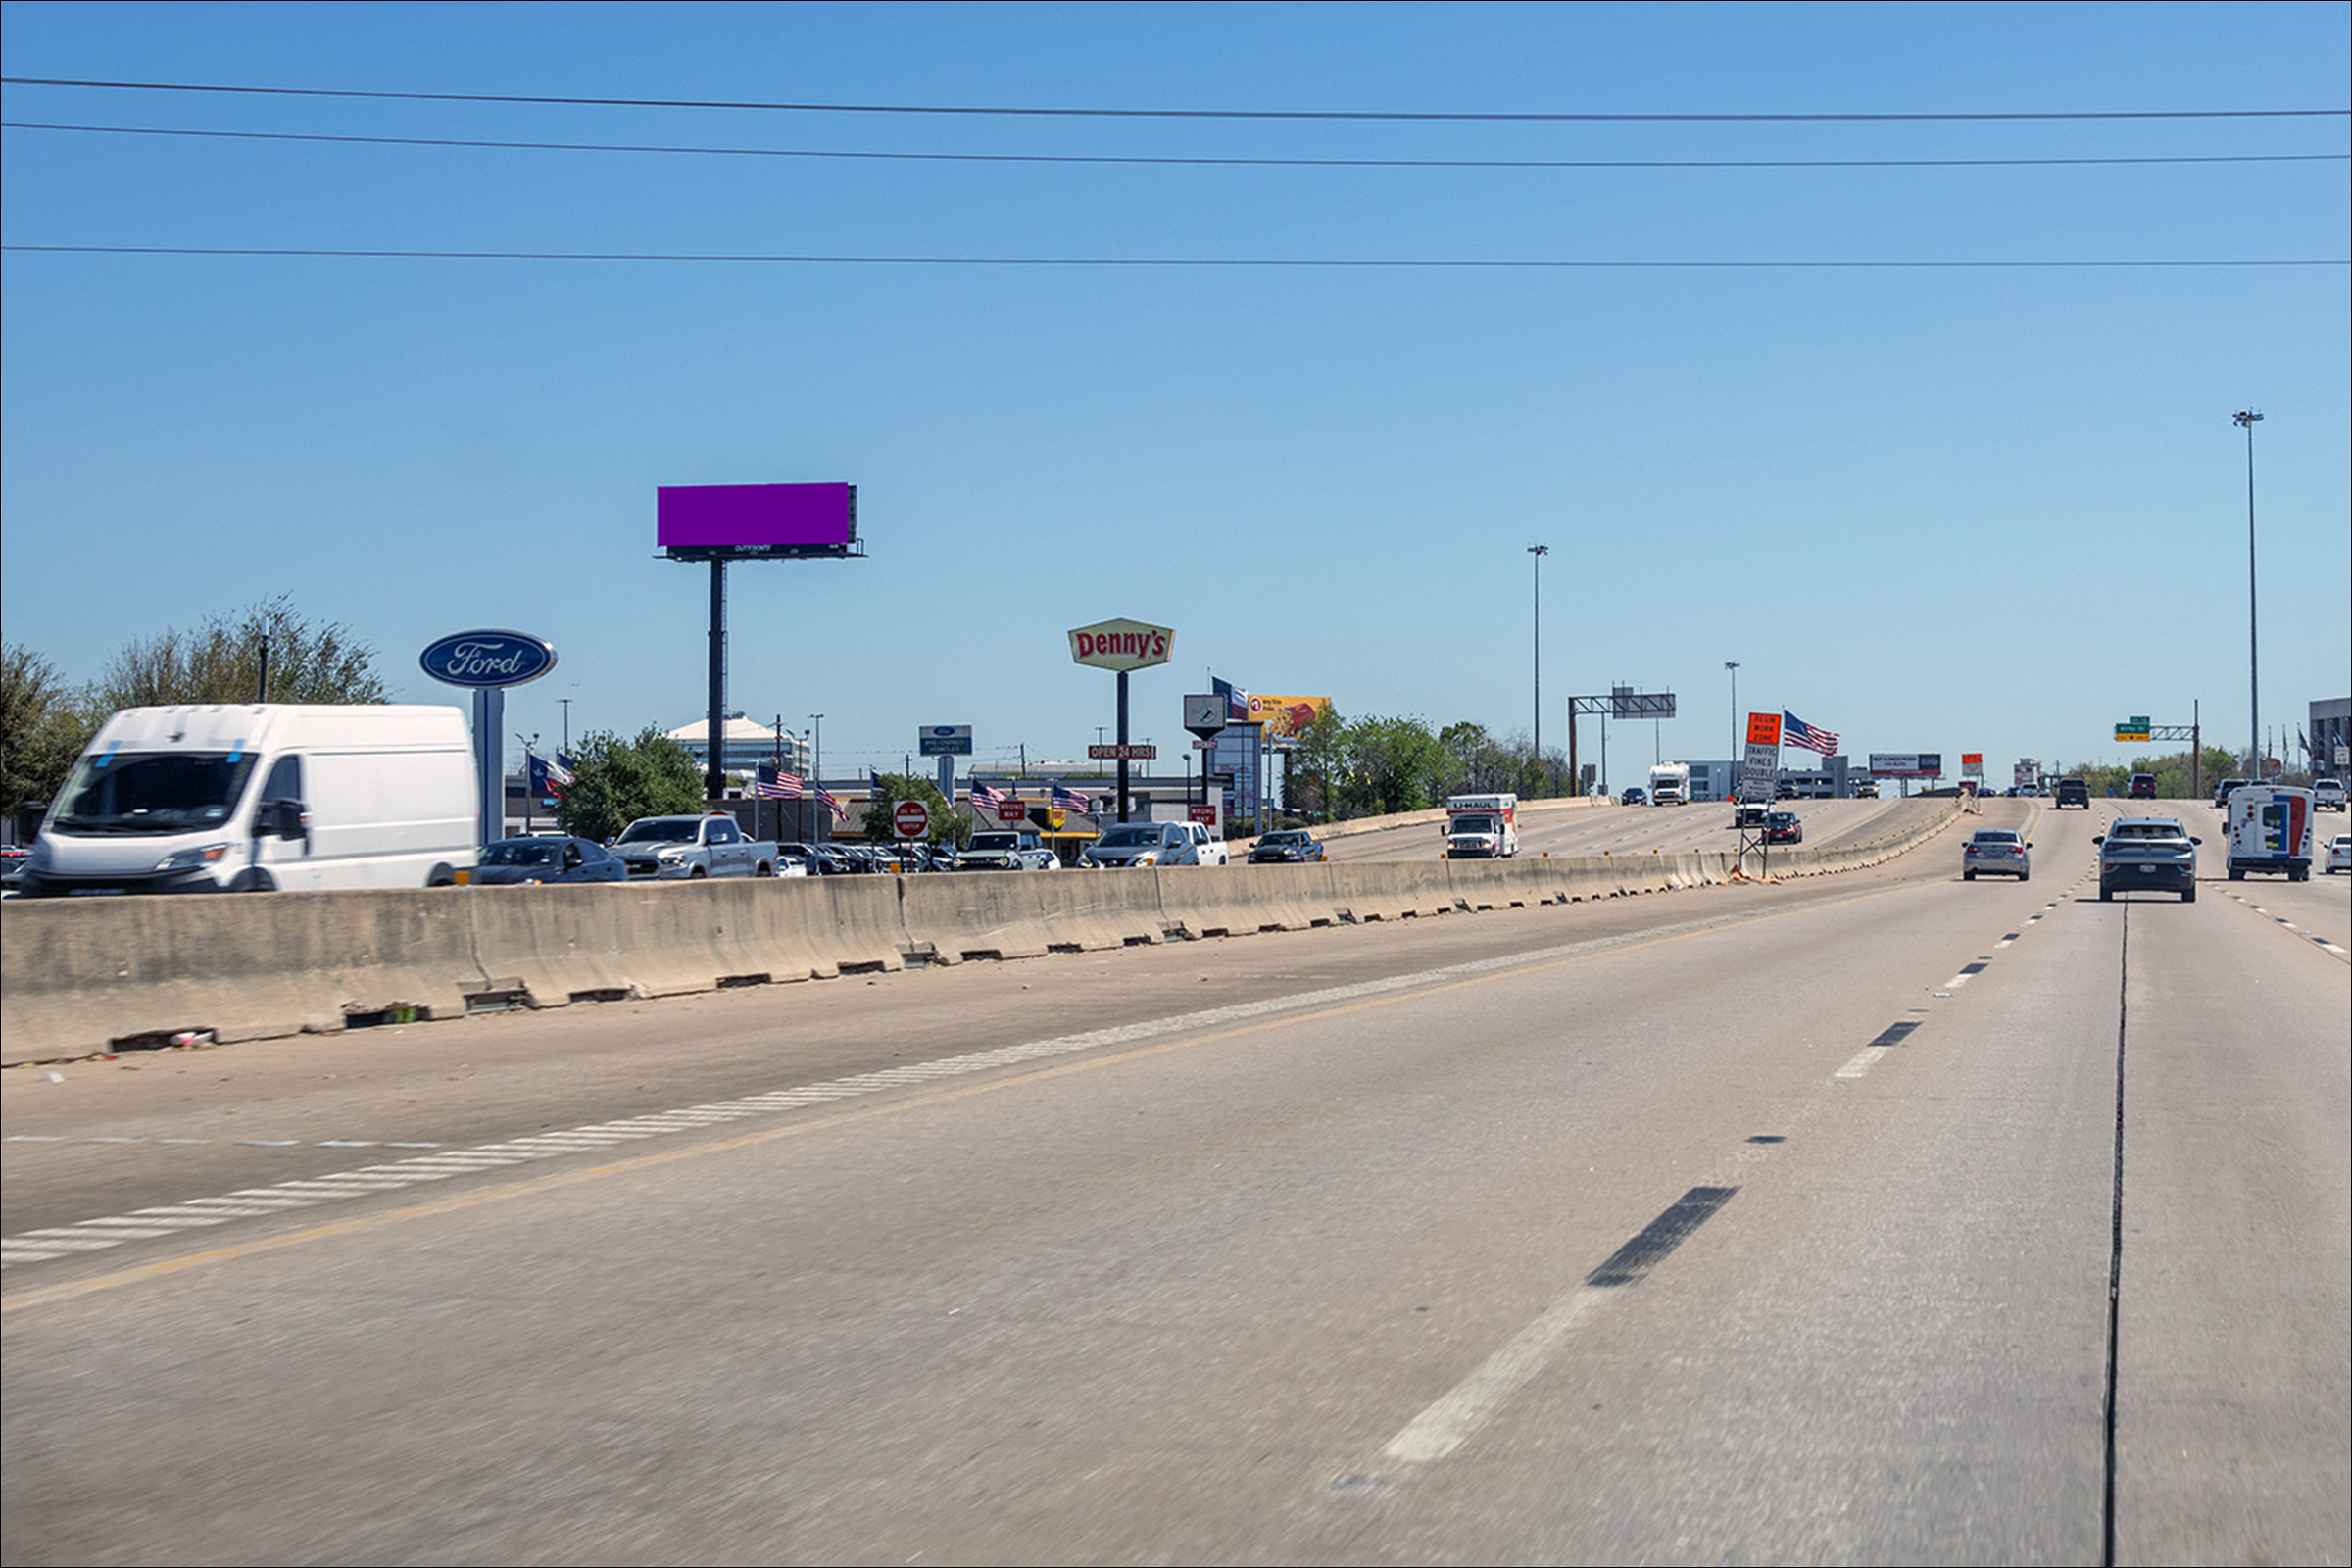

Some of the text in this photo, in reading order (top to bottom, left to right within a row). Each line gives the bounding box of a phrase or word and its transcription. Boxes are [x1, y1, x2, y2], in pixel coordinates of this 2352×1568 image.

[1076, 629, 1166, 659] Denny's
[447, 642, 523, 675] Ford
[1754, 714, 1776, 723] BEGIN
[1754, 733, 1773, 742] ZONE
[1091, 747, 1151, 757] OPEN 24 HRS
[1747, 745, 1776, 756] TRAFFIC
[1749, 757, 1772, 766] FINES
[1745, 767, 1773, 777] DOUBLE
